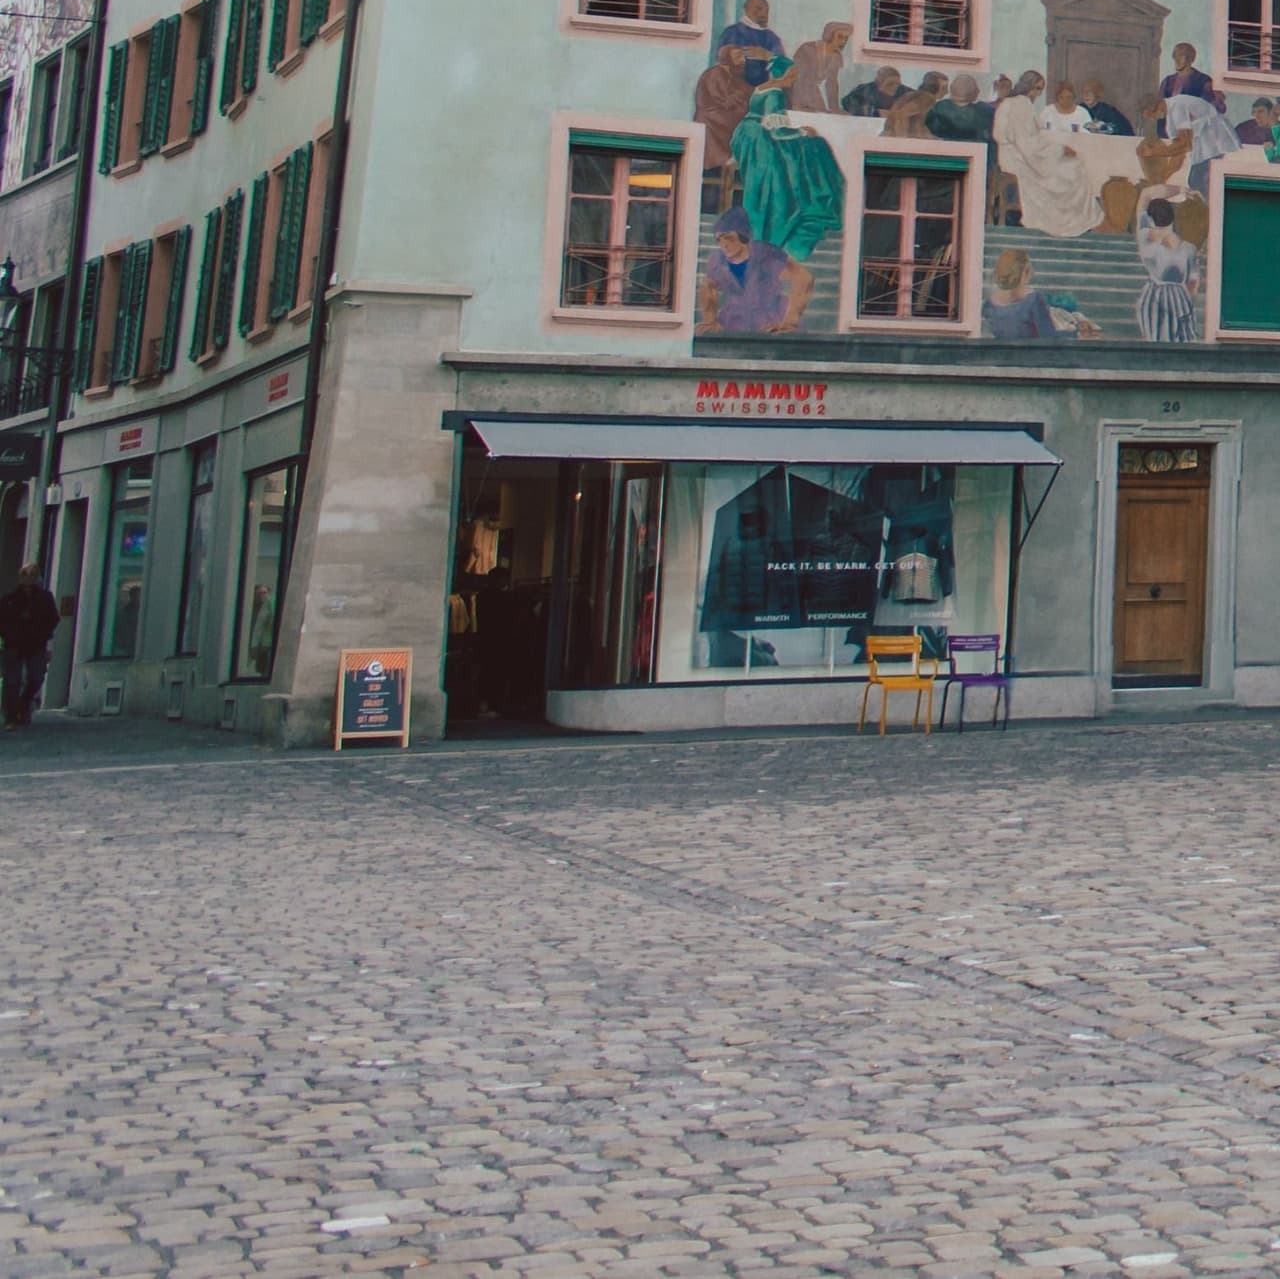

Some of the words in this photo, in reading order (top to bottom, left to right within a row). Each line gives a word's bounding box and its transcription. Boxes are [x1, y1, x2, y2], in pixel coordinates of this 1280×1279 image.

[696, 381, 827, 400] MAMMUT
[695, 402, 767, 414] SWISS
[774, 404, 826, 416] 1862
[1163, 400, 1181, 413] 20
[767, 561, 796, 571] PACK
[817, 561, 832, 571] BE
[836, 561, 870, 571] WARM.
[875, 561, 895, 571] GET
[755, 614, 790, 622] WARMTH
[807, 612, 868, 621] PERFORMANCE
